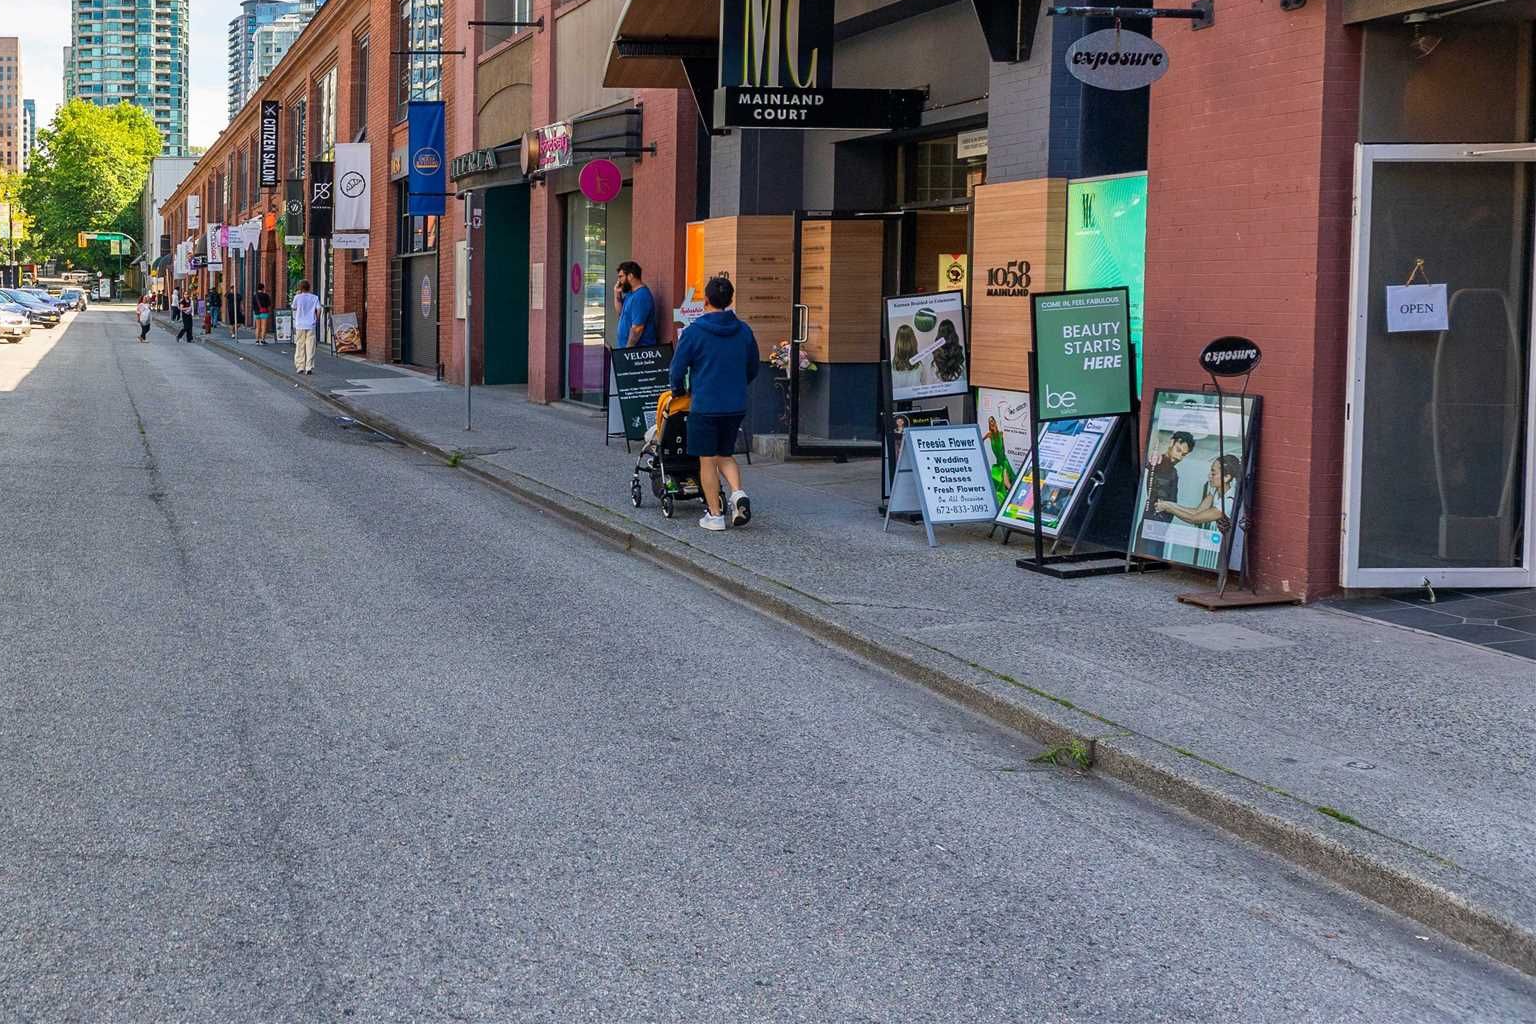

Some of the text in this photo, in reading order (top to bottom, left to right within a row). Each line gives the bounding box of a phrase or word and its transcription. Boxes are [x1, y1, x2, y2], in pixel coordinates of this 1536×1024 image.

[1071, 49, 1163, 71] exposure
[738, 92, 825, 106] MAINLAND
[753, 108, 808, 121] COURT
[263, 119, 276, 150] CITIZEN
[986, 260, 1031, 288] 1058
[986, 289, 1029, 297] MAINLAND
[1041, 301, 1062, 309] COME
[1086, 296, 1119, 305] FABULOUS
[1400, 302, 1434, 315] OPEN
[1063, 322, 1121, 338] BEAUTY
[1064, 338, 1121, 355] STARTS
[624, 350, 662, 361] VELORA
[1204, 348, 1258, 366] exposure
[1083, 355, 1123, 370] HERE
[1046, 384, 1077, 409] be
[917, 437, 975, 449] Freesia Flower
[933, 456, 969, 465] Wedding
[934, 466, 973, 474] Bouquets
[956, 485, 986, 493] Flowers
